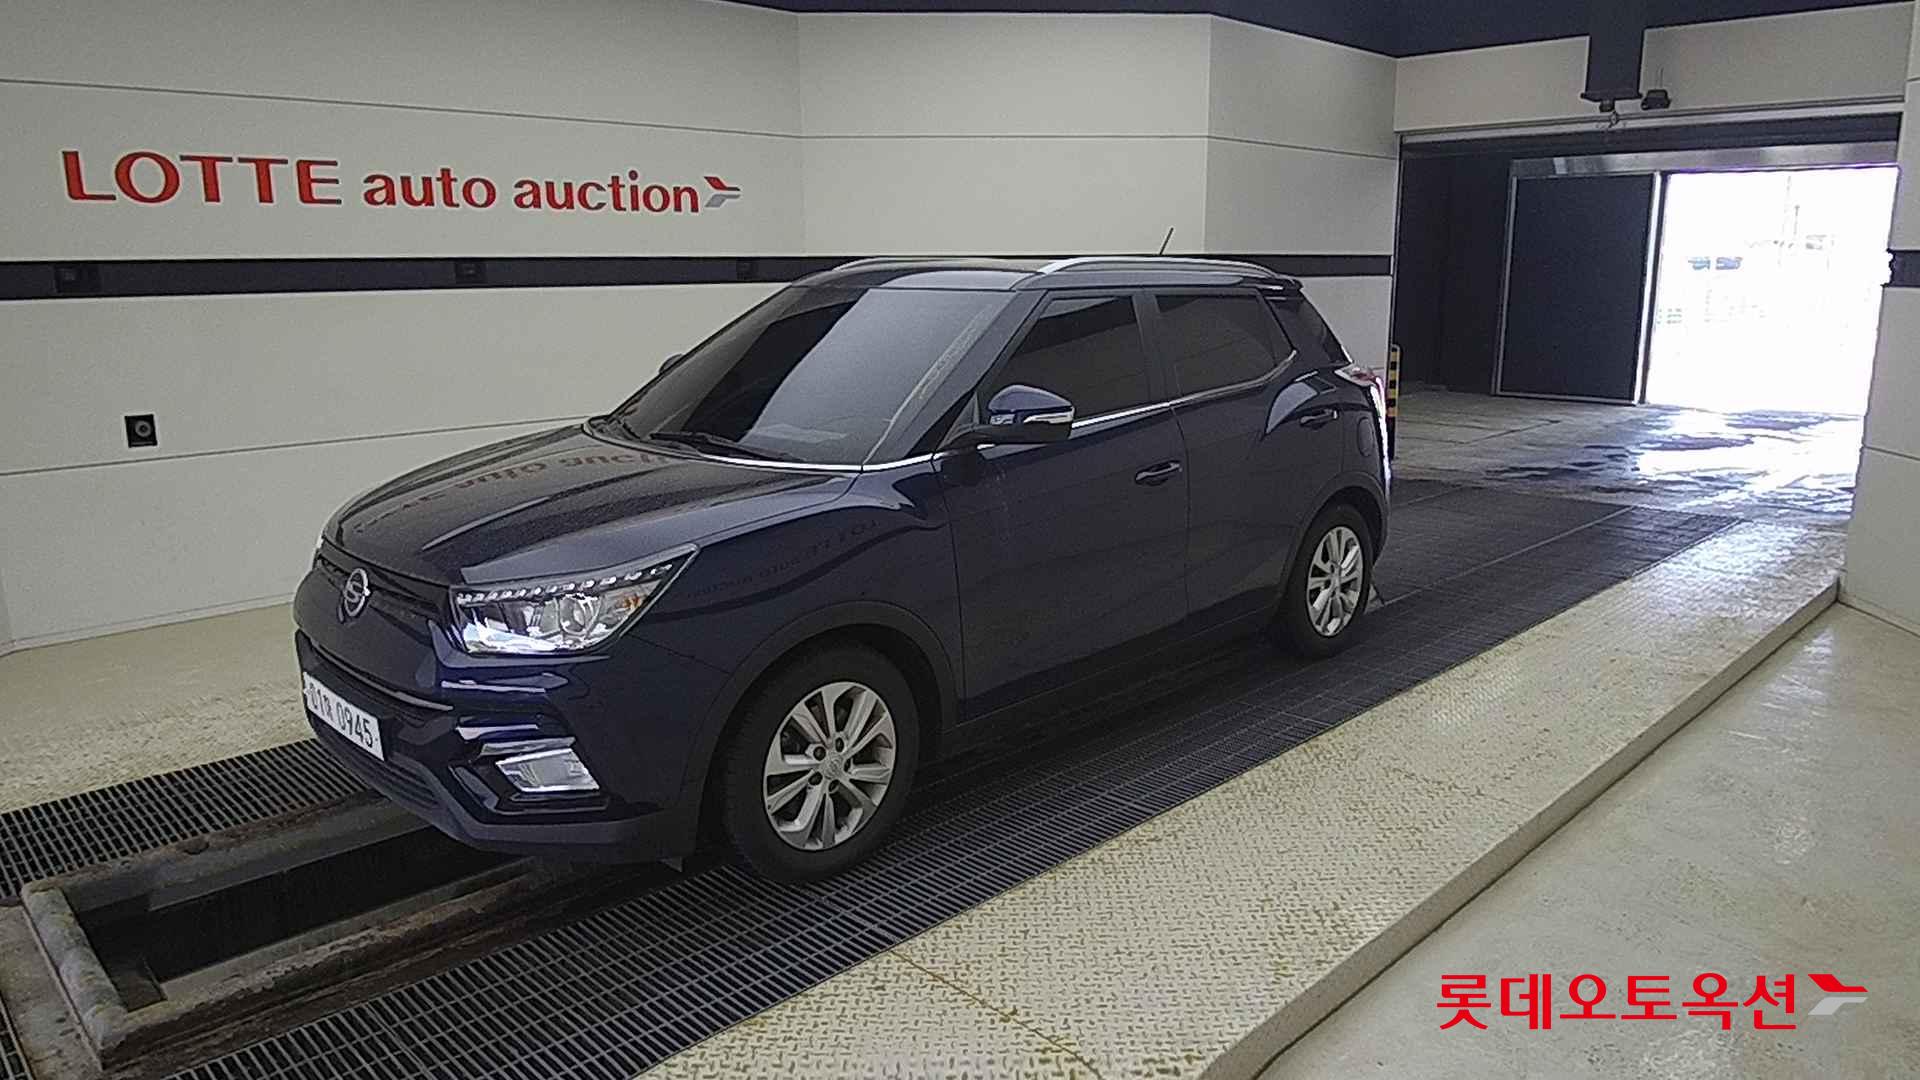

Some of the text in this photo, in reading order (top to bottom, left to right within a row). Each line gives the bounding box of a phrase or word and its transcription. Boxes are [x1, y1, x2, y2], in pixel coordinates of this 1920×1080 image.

[62, 150, 699, 213] LOTTE auto auction
[336, 702, 373, 748] 0945
